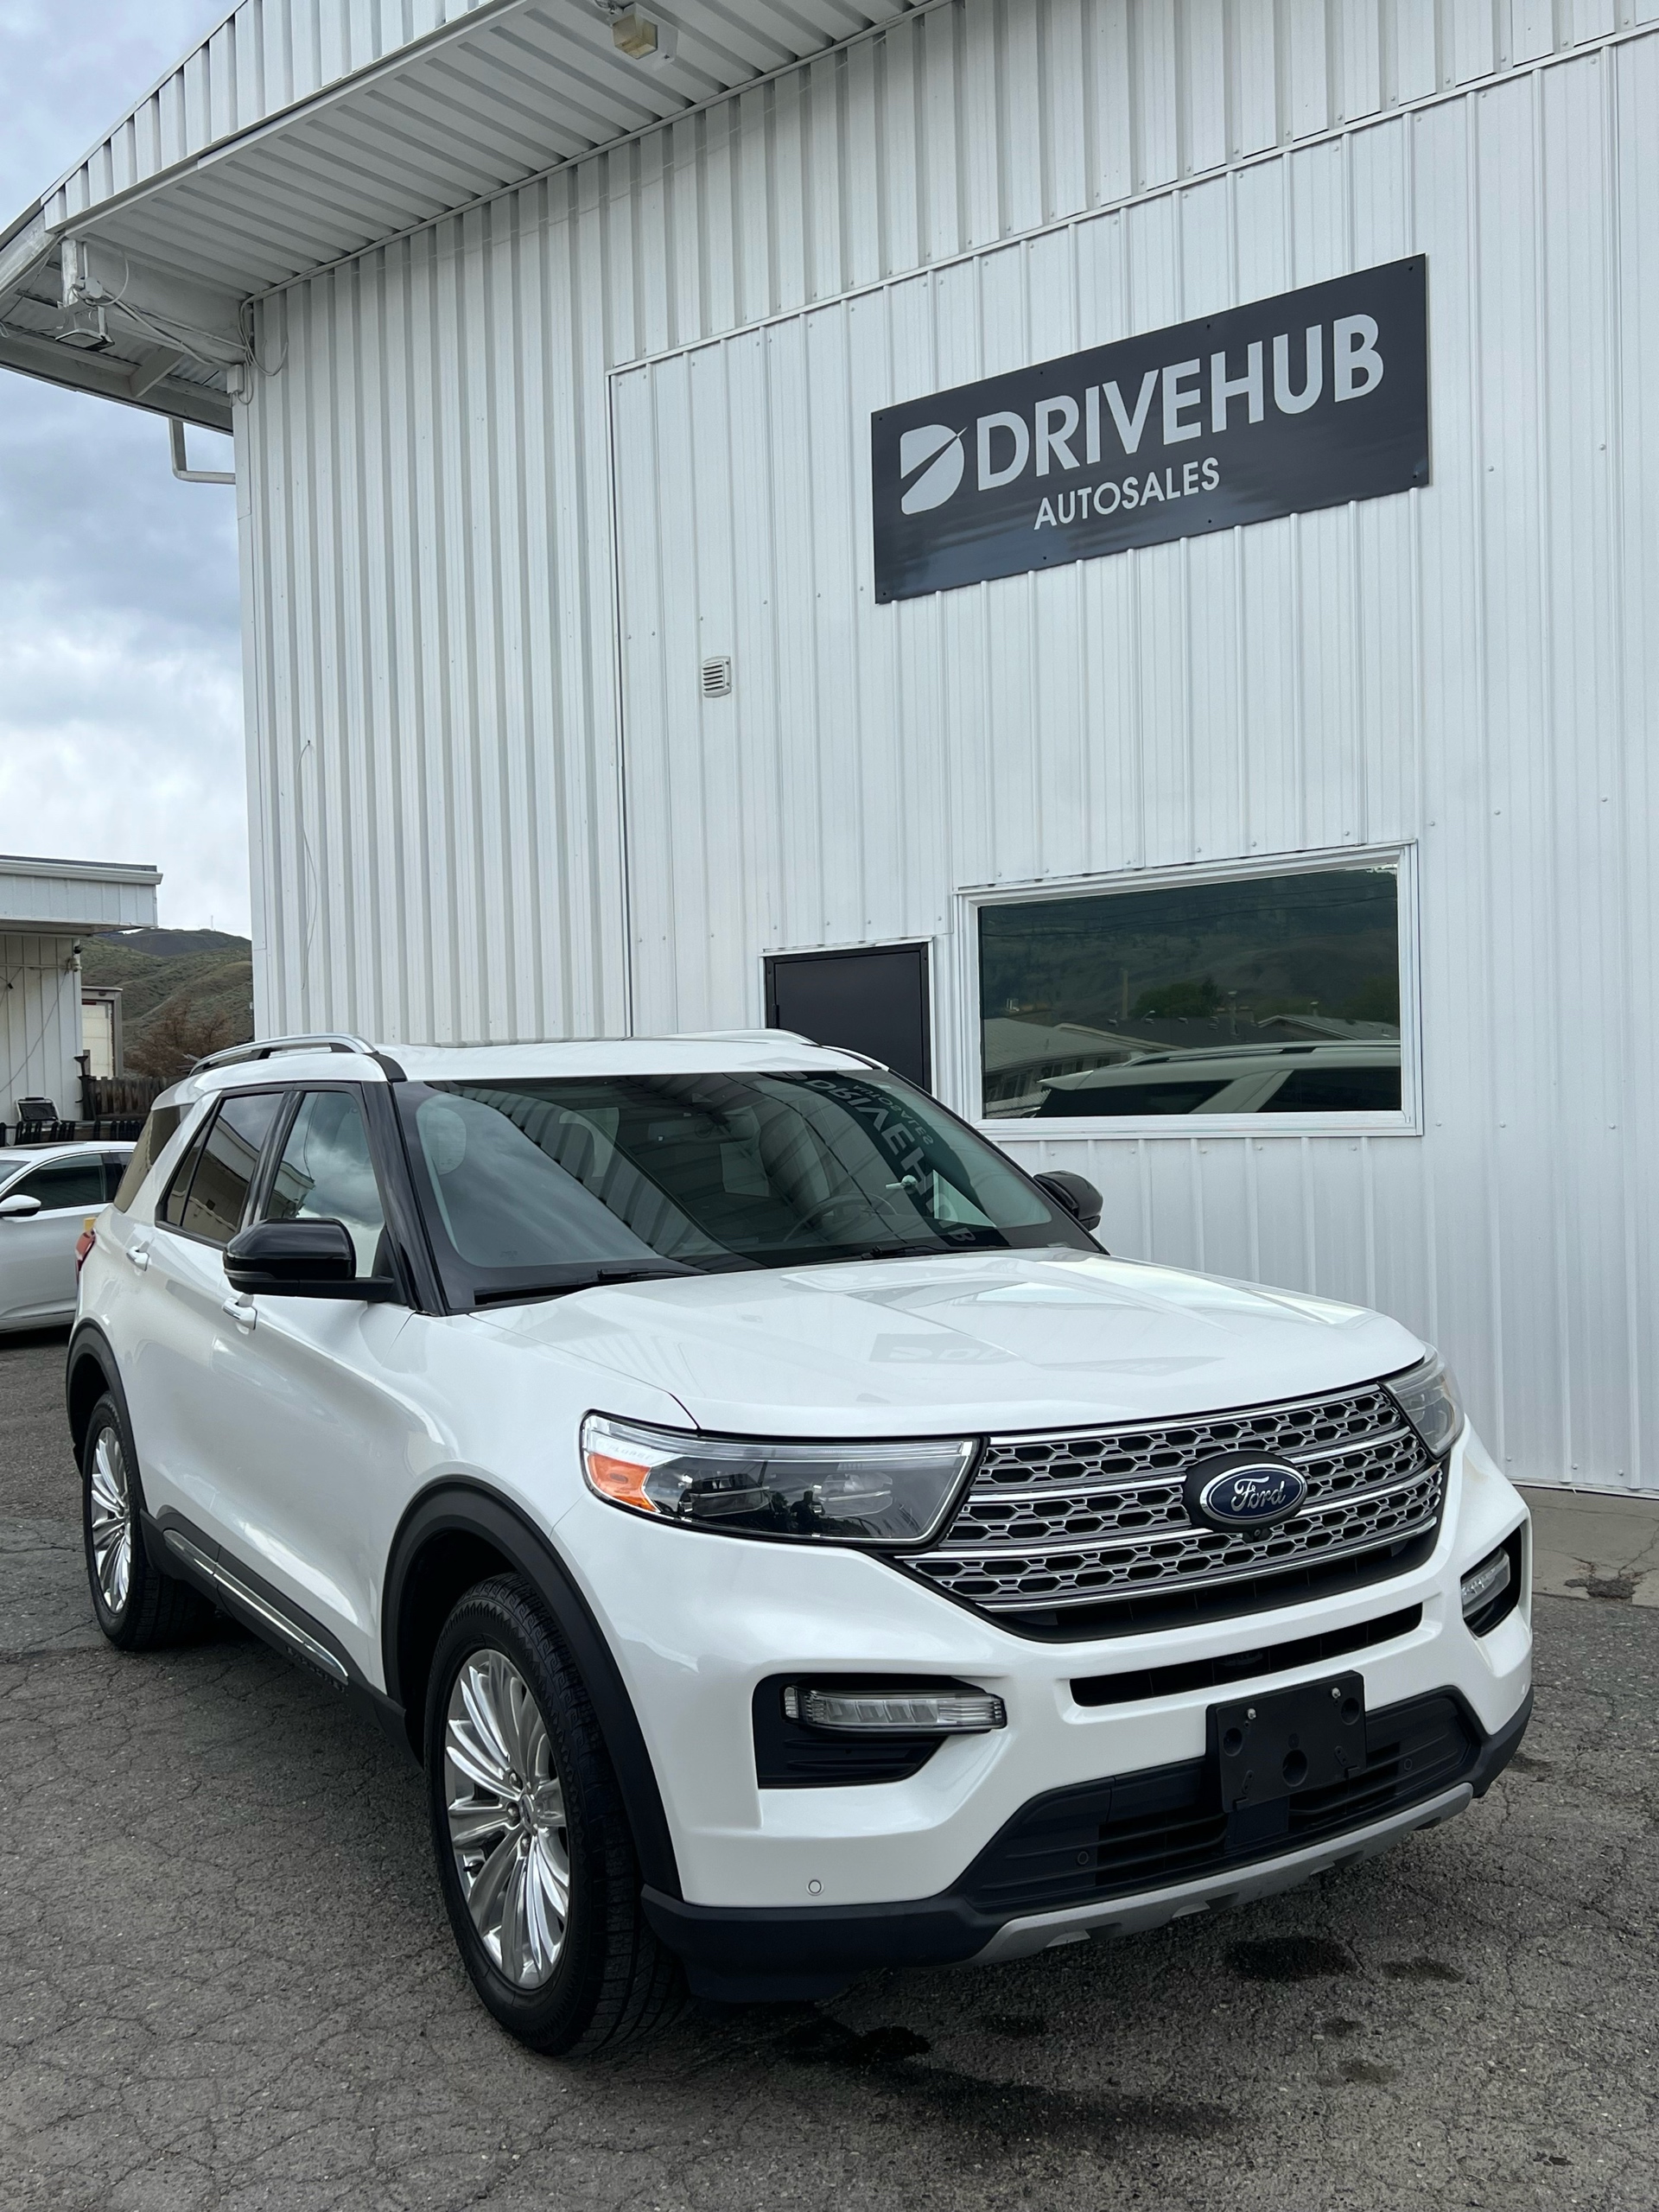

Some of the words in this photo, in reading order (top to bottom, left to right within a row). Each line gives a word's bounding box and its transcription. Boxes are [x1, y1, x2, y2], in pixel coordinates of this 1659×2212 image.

[976, 314, 1384, 491] DRIVEHUB
[1033, 457, 1220, 531] AUTOSALES
[1230, 1476, 1286, 1511] Ford
